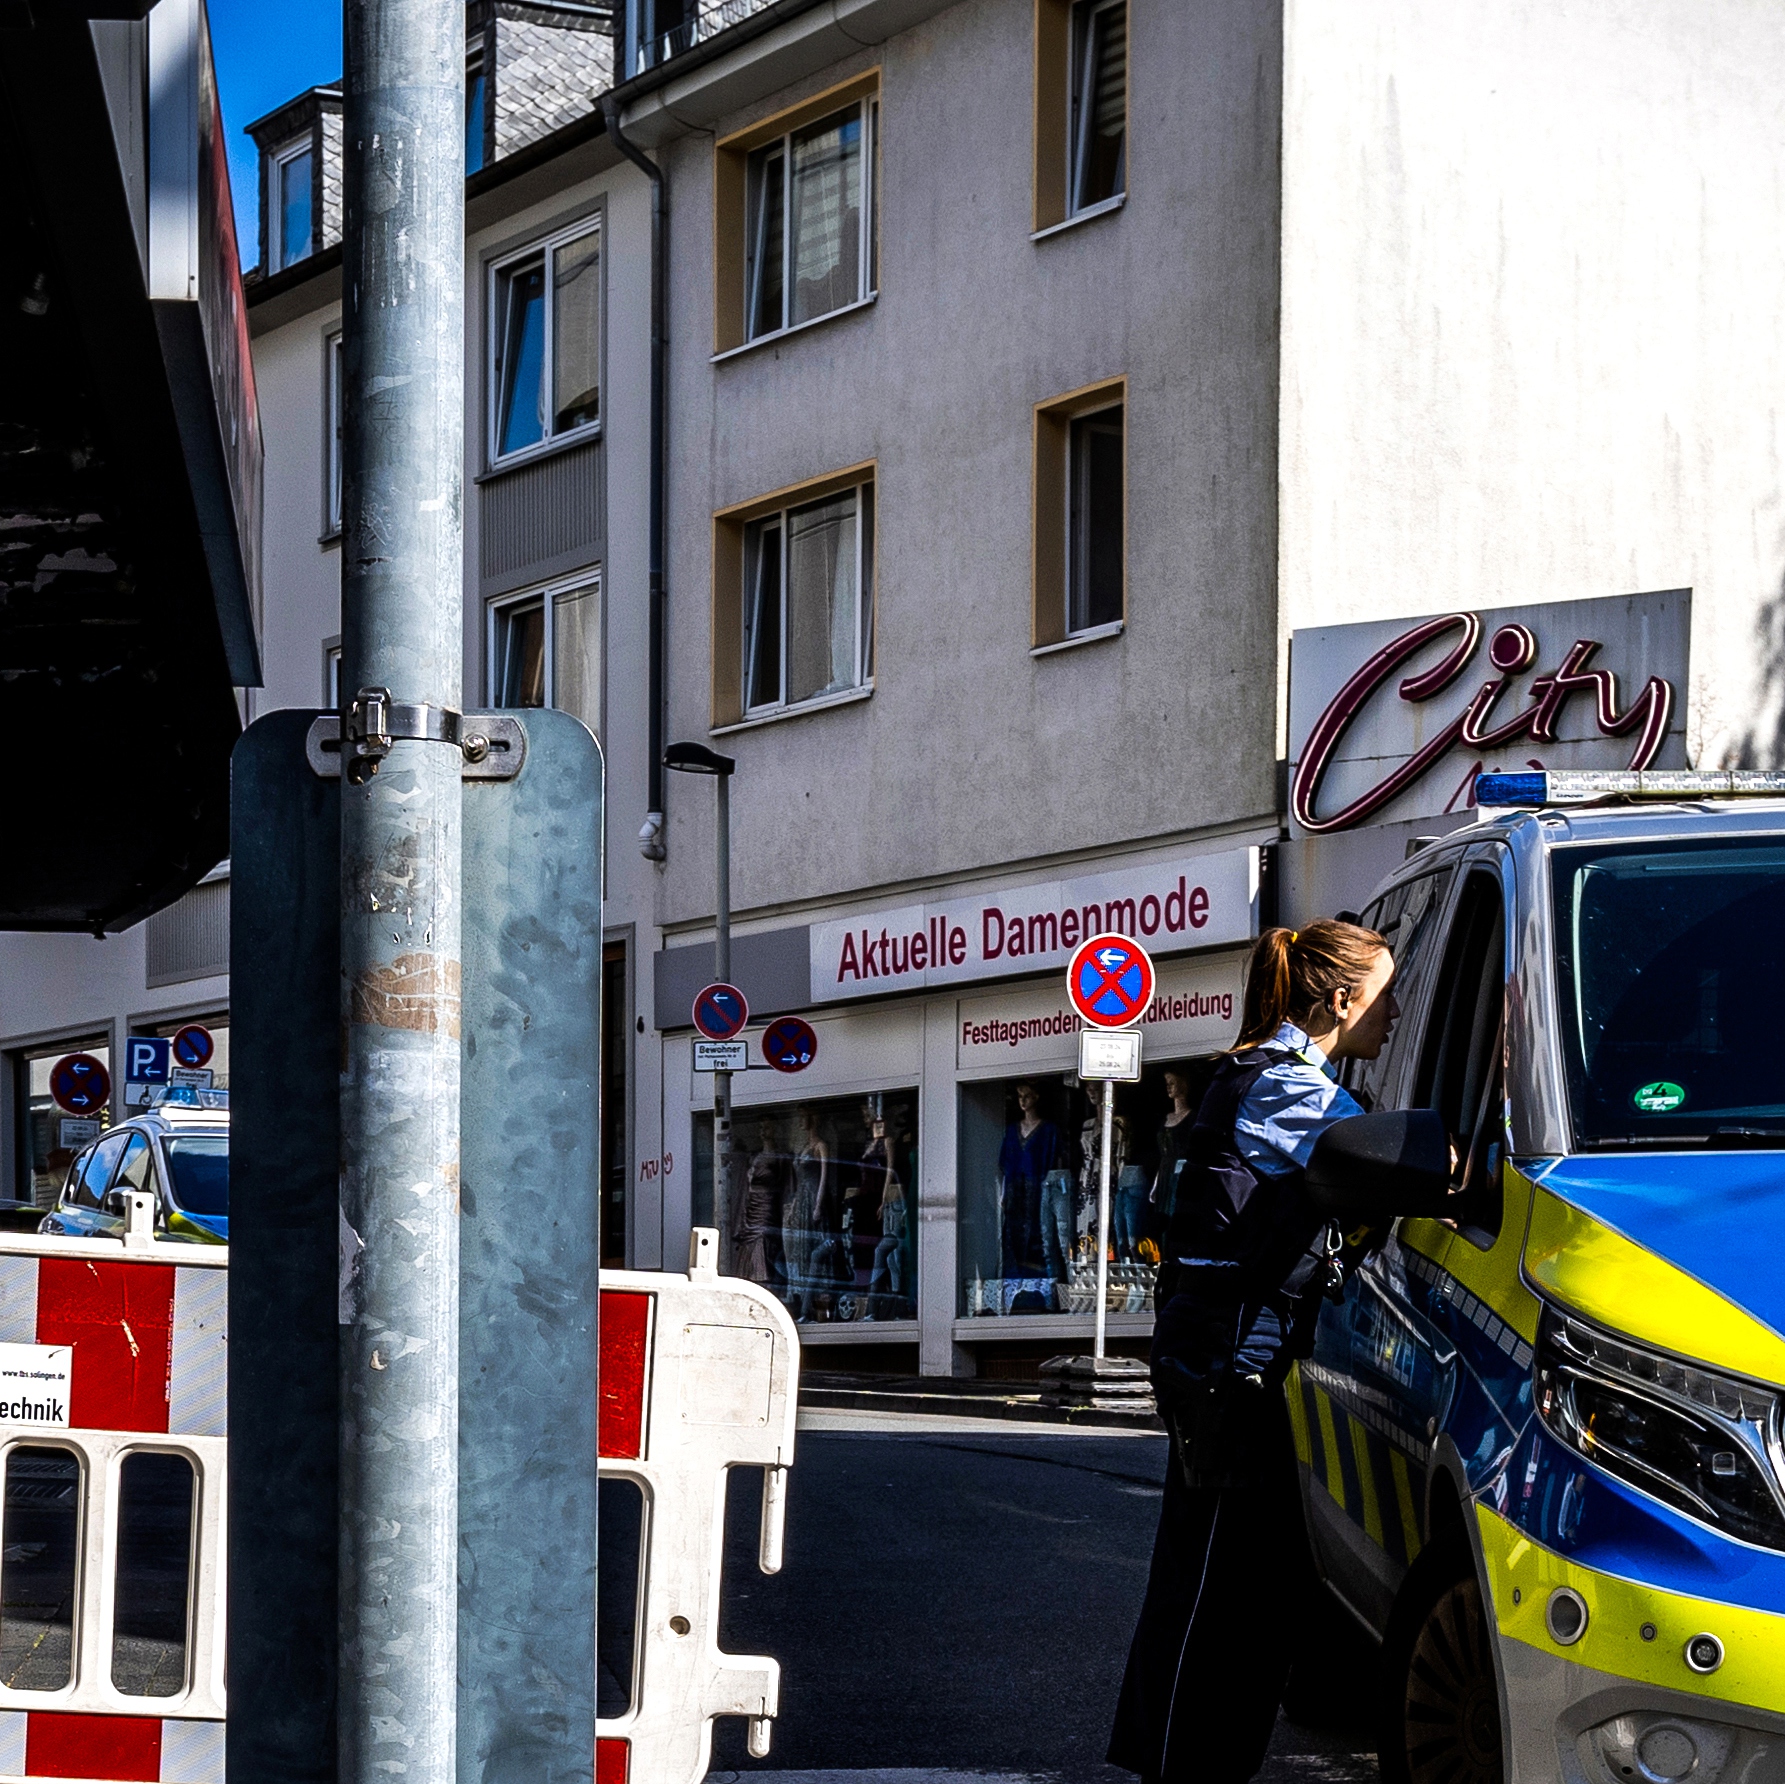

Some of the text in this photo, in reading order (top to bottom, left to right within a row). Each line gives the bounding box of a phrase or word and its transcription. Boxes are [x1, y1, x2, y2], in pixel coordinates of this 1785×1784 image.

[1292, 611, 1672, 834] City
[837, 875, 1210, 984] Aktuelle Damenmode
[962, 1009, 1082, 1048] Festtagsmoden
[133, 1044, 156, 1076] P
[699, 1045, 742, 1054] Bewohner
[714, 1059, 728, 1068] frei
[1652, 1083, 1668, 1097] 4
